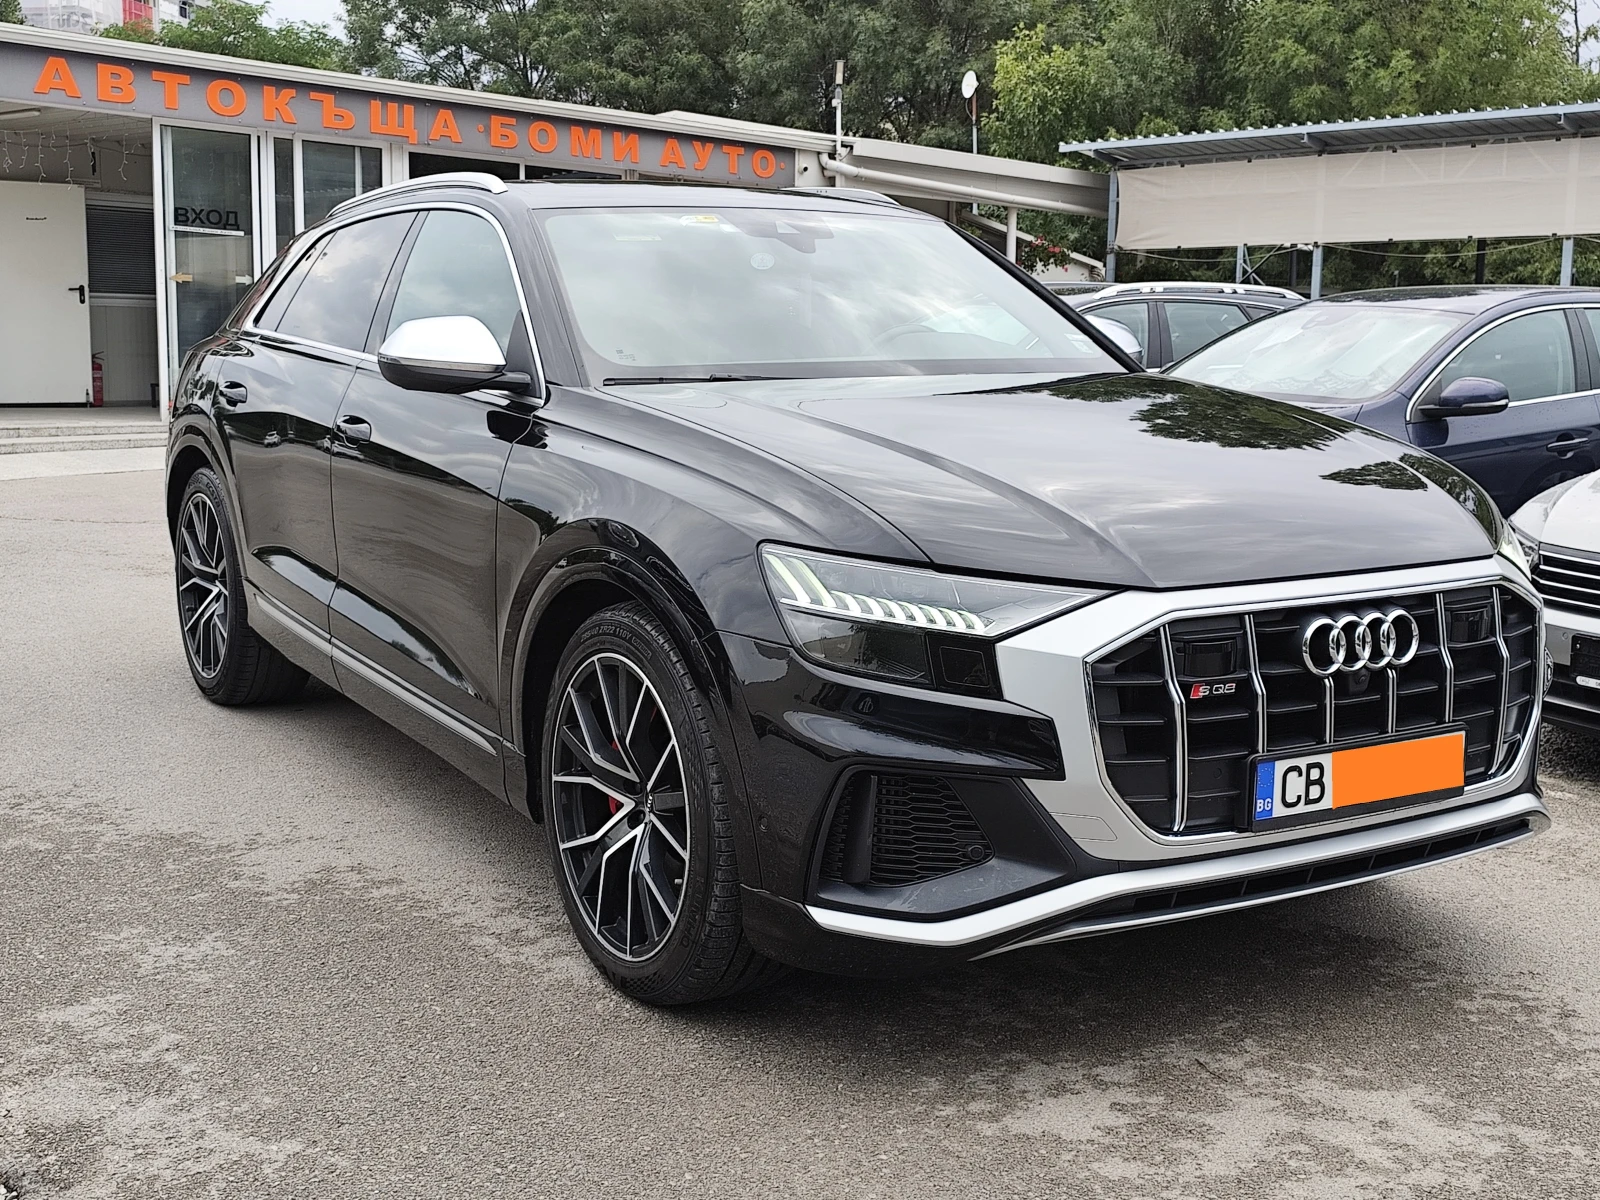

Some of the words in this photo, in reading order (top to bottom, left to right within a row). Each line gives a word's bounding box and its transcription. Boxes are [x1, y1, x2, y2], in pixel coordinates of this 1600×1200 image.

[34, 56, 463, 145] АВТОКЪЩА
[489, 114, 641, 164] БОМИ
[659, 138, 777, 178] АУТО
[174, 207, 240, 230] ВХОД
[1281, 762, 1326, 808] CB
[1256, 798, 1272, 812] BG
